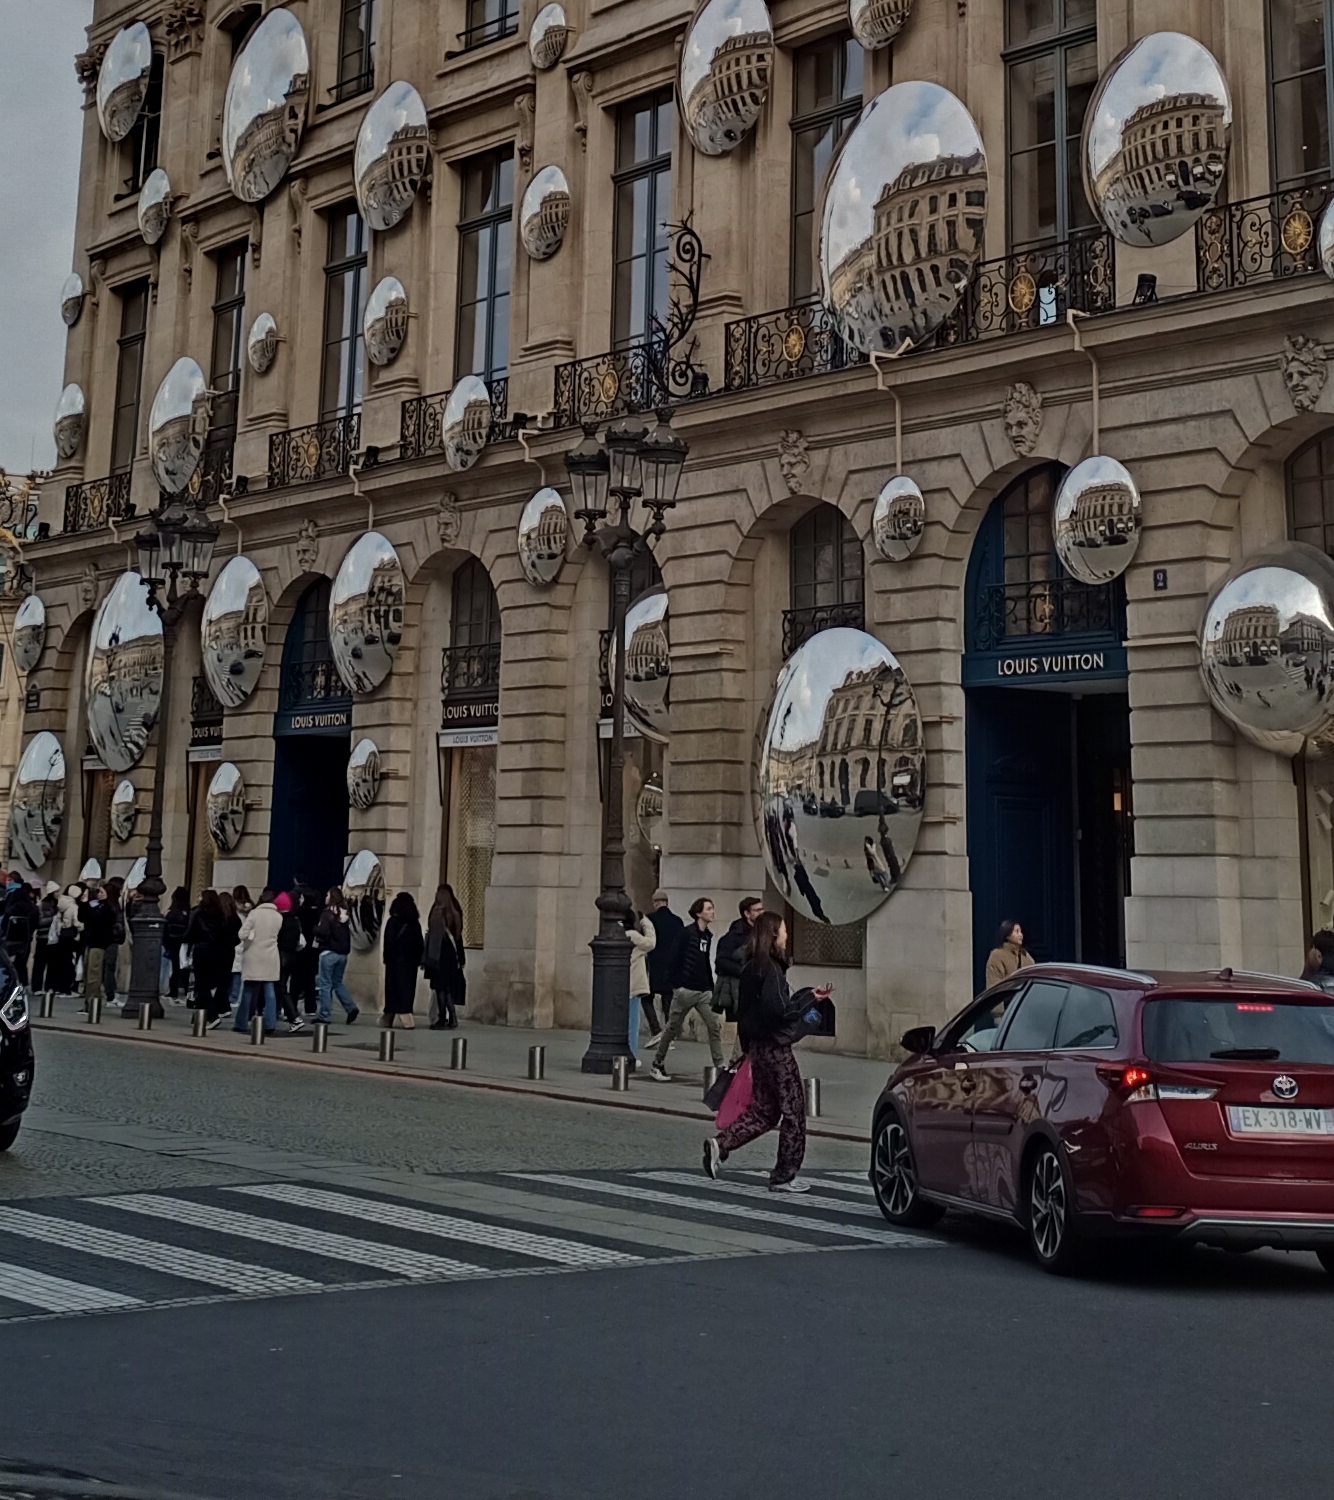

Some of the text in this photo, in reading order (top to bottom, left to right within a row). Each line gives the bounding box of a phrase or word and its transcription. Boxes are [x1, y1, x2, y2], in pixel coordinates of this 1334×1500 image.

[998, 653, 1104, 675] LOUIS VUITTON
[443, 703, 499, 719] LOUIS VUITTO
[291, 713, 347, 728] LOUIS VUITTON
[1242, 1109, 1322, 1130] EX-318-WV
